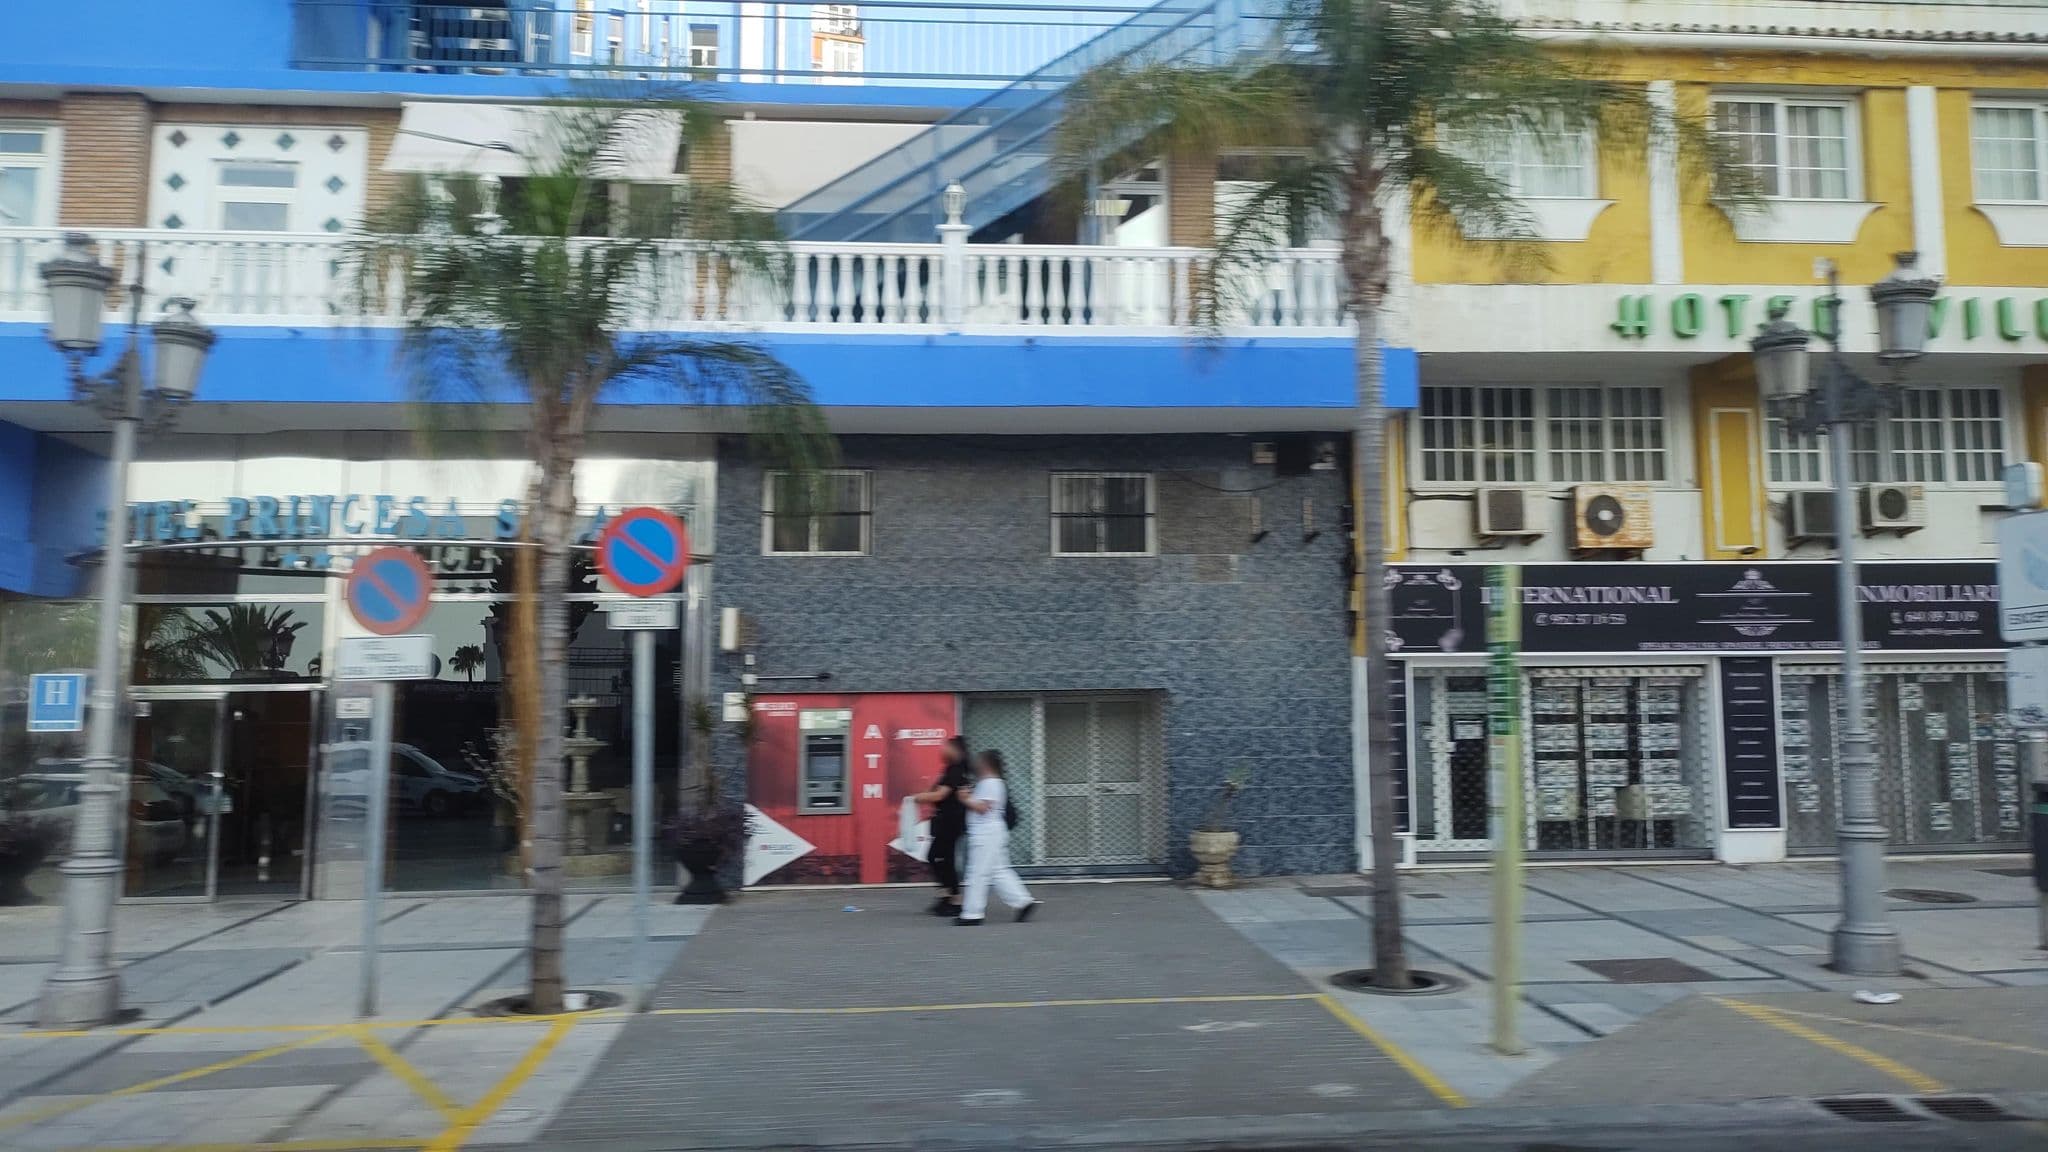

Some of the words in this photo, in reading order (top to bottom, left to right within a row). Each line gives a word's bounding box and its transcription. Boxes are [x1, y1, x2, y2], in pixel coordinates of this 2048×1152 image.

[224, 495, 466, 539] PRINCESA
[1480, 586, 1681, 604] ITERNATIONAL
[1855, 585, 2000, 603] NMOBILIARI
[41, 680, 72, 705] H
[863, 724, 884, 799] ATM
